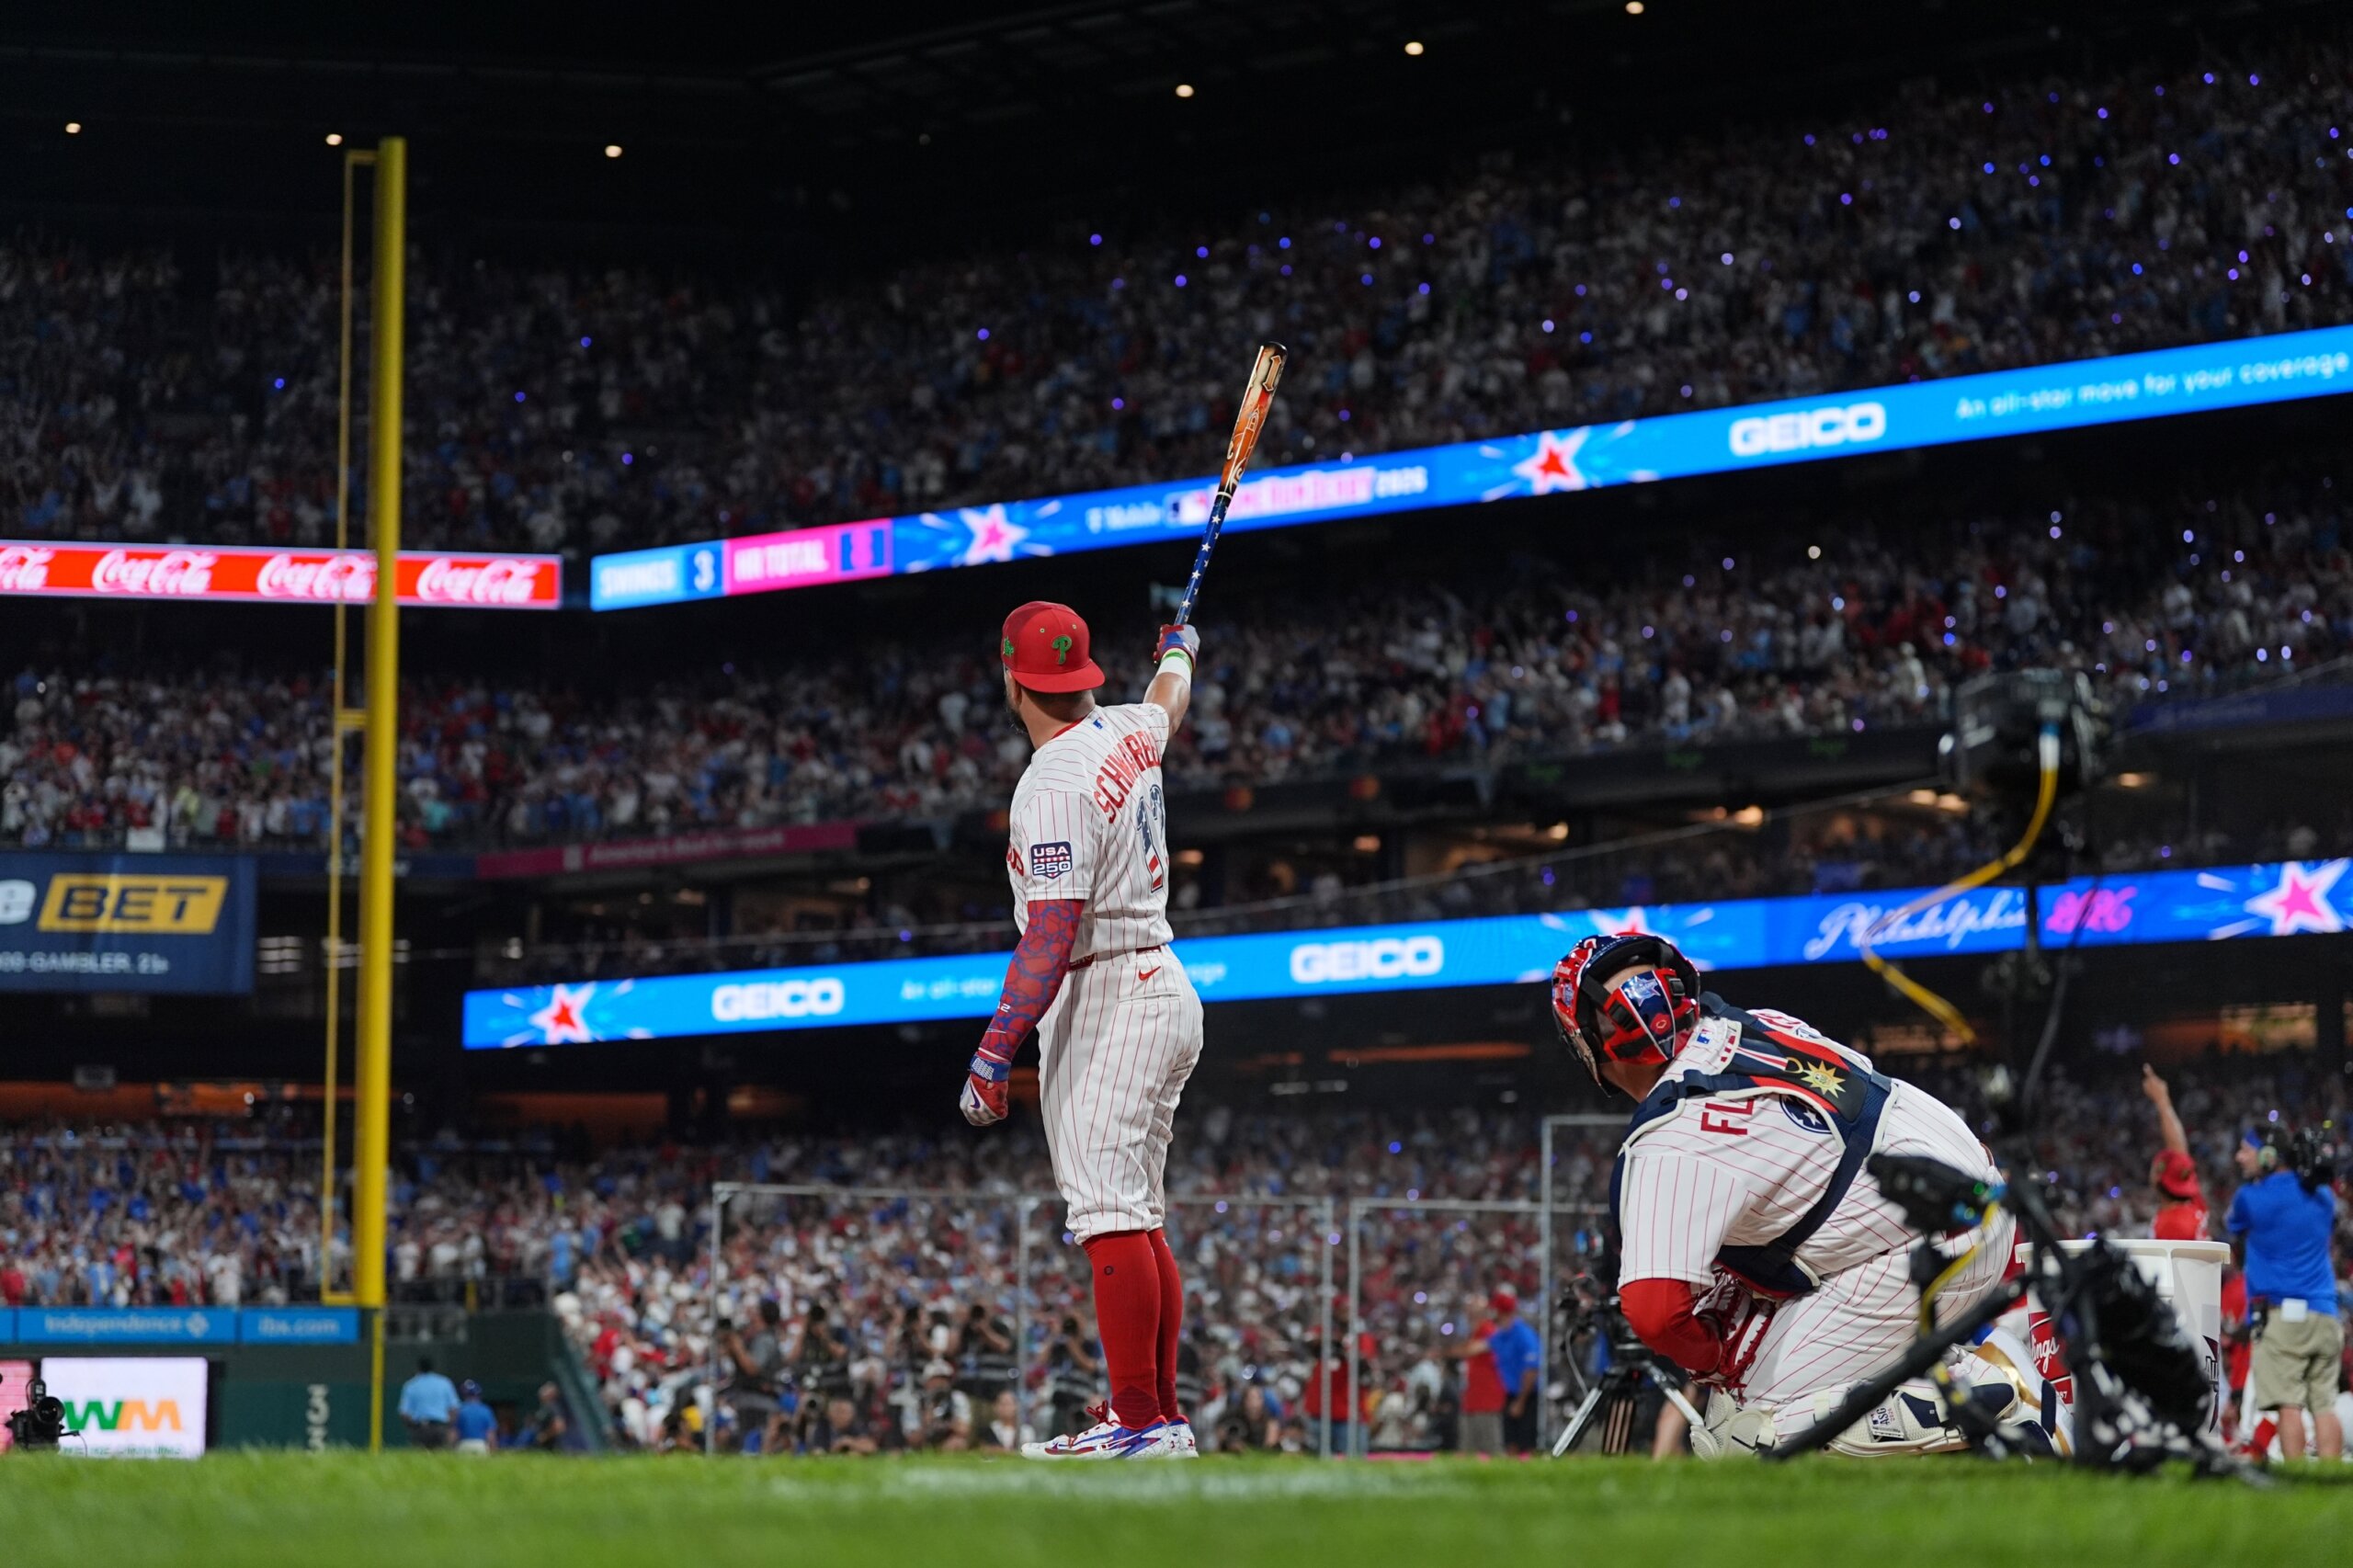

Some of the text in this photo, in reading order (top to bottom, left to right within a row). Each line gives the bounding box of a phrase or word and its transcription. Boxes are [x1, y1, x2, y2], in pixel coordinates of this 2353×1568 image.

[1956, 350, 2350, 421] An all-star move for your coverage
[1730, 403, 1886, 457] GEICO
[693, 550, 714, 592] 3
[1051, 634, 1073, 665] P
[1093, 730, 1163, 824] SCHWARB
[1033, 846, 1068, 858] USA
[1033, 860, 1072, 875] 250
[57, 886, 208, 922] BET
[1290, 935, 1445, 983] GEICO
[710, 978, 846, 1022] GEICO
[45, 1315, 184, 1336] Independence
[2030, 1335, 2060, 1374] ings
[64, 1400, 182, 1431] WM
[1876, 1407, 1890, 1426] ASG
